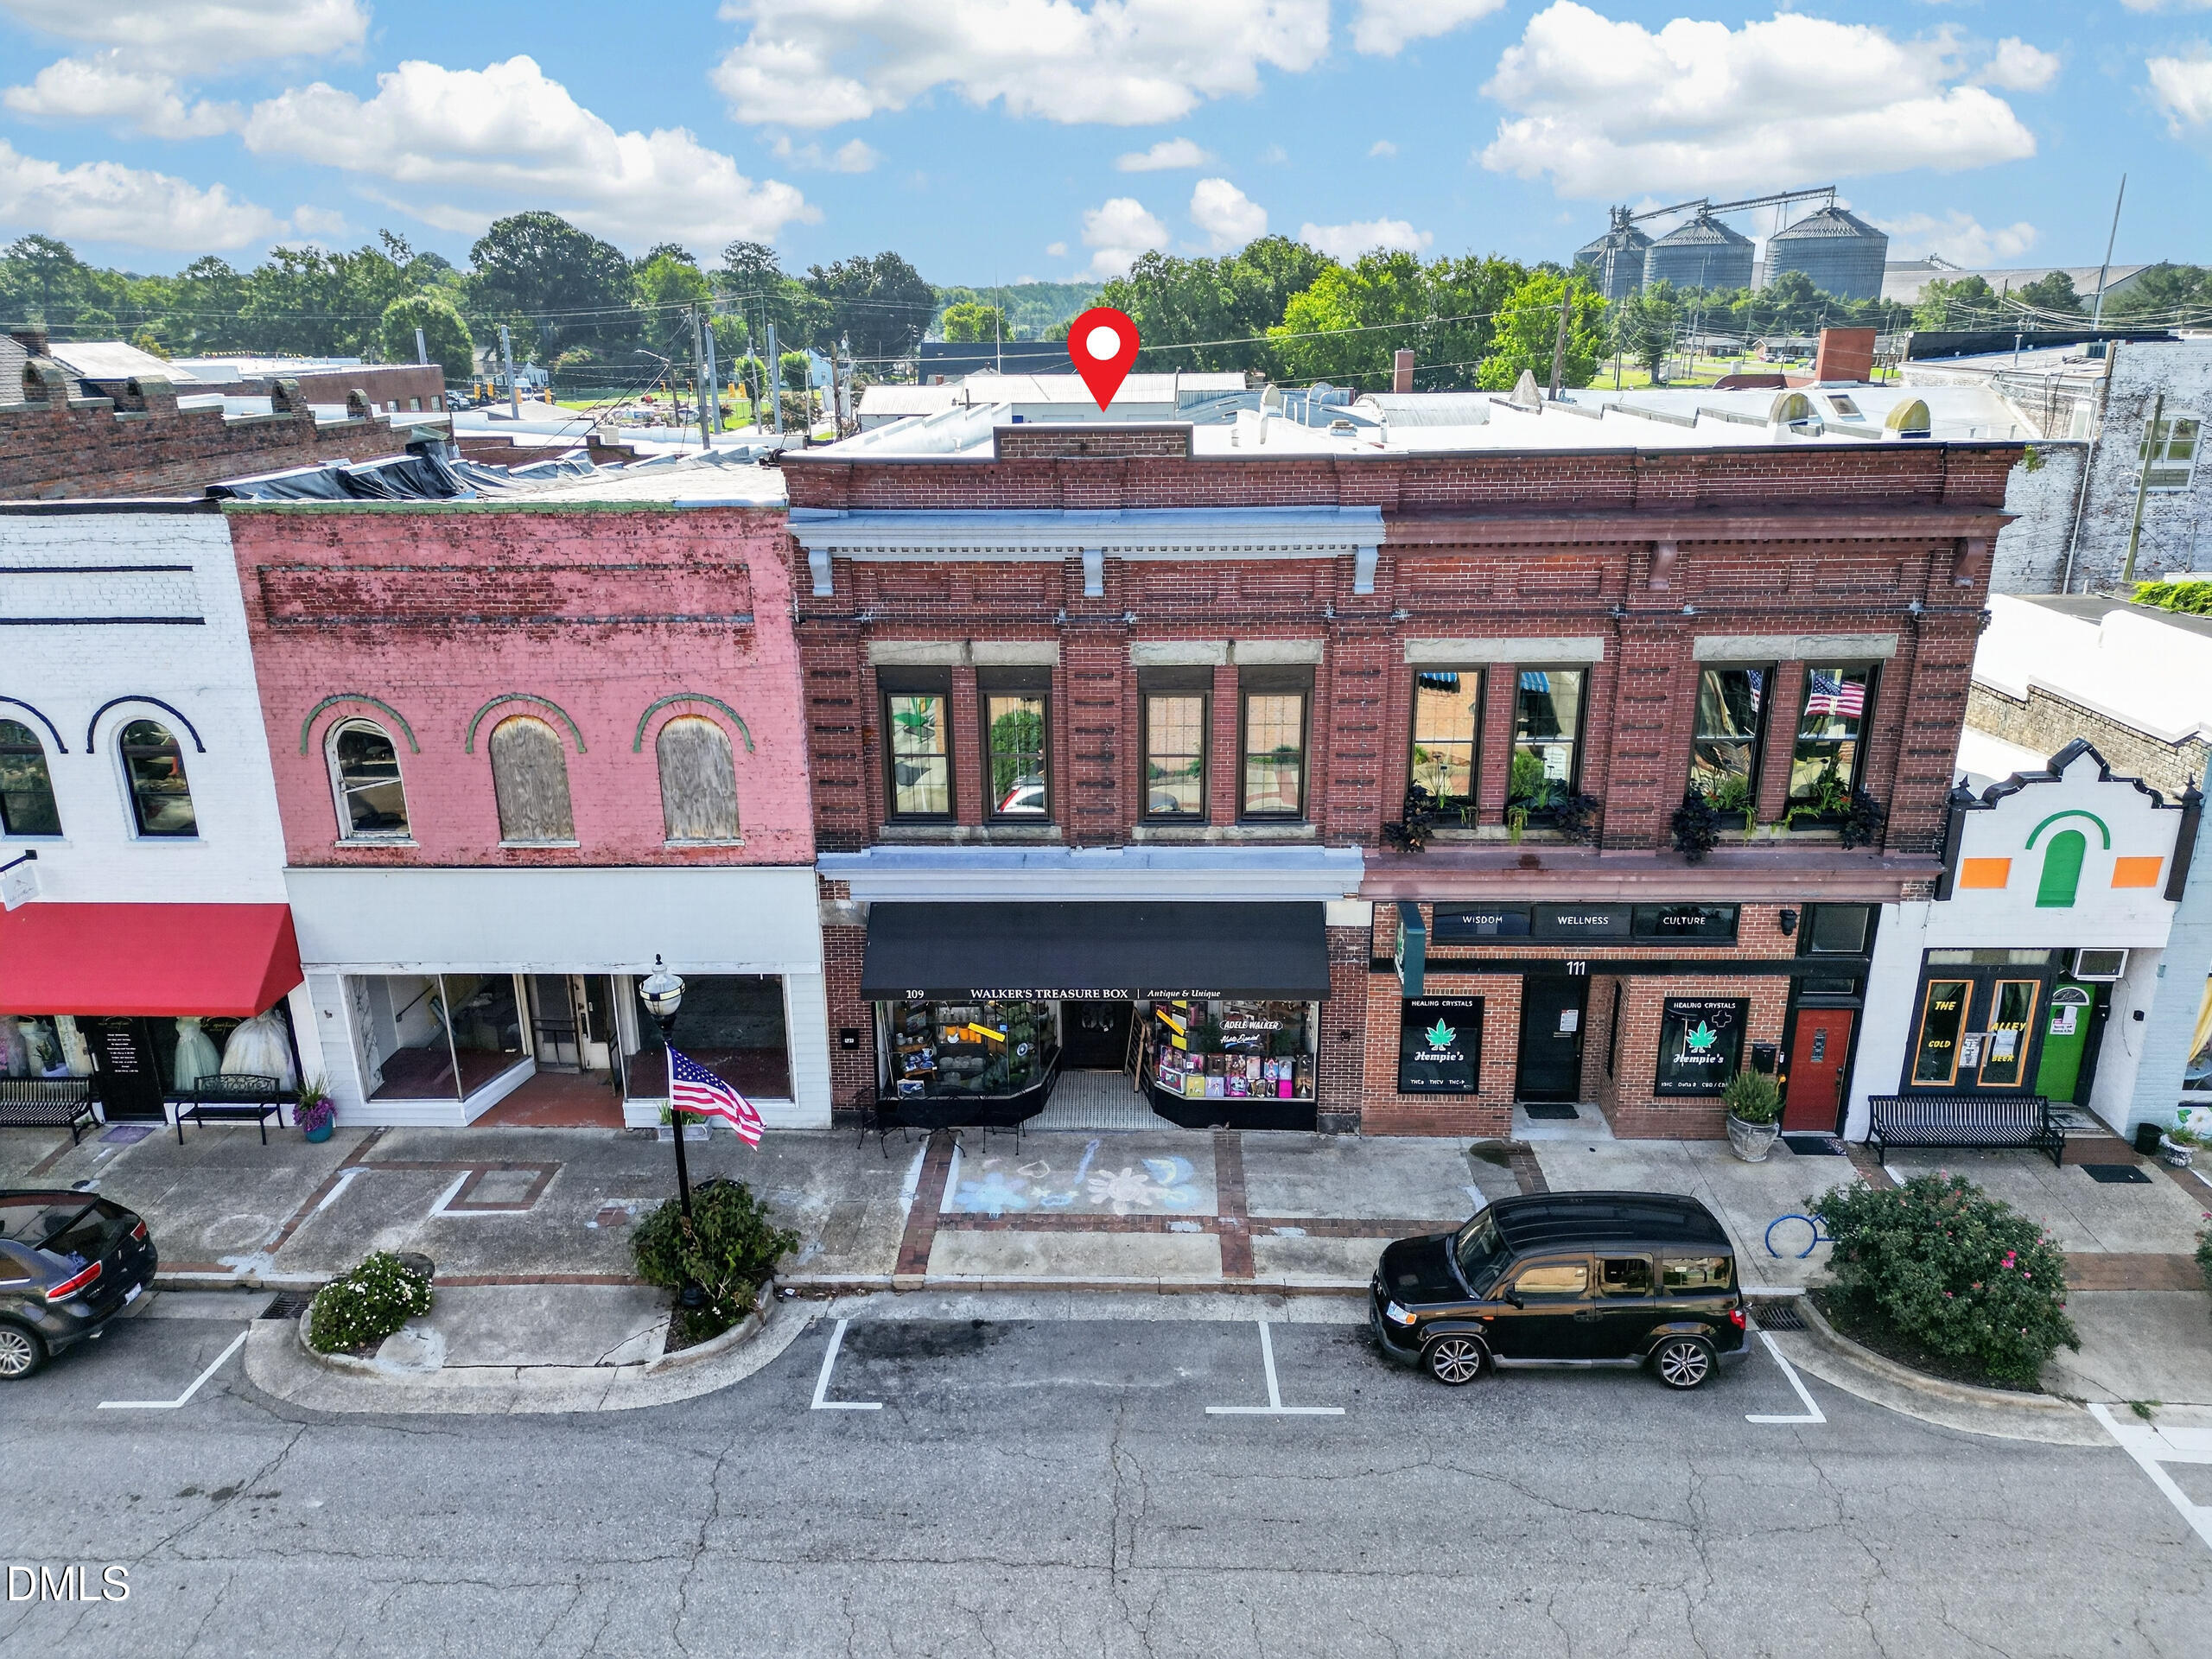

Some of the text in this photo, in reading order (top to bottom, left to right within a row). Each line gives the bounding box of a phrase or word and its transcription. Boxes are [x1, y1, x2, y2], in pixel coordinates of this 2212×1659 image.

[1462, 915, 1706, 925] WISDOM WELLNESS CULTURE
[1567, 961, 1586, 976] 111
[906, 988, 1221, 1000] 109 WALKER'S TREASURE BOX Antique & Unique
[1935, 1001, 1956, 1011] THE
[1224, 1020, 1280, 1030] ADELE WALKER
[1990, 1021, 2026, 1032] ALLEY
[1928, 1039, 1951, 1048] COLD
[1414, 1051, 1464, 1064] Hempie's
[1673, 1053, 1724, 1065] Hempie's
[1991, 1054, 2014, 1063] BEER
